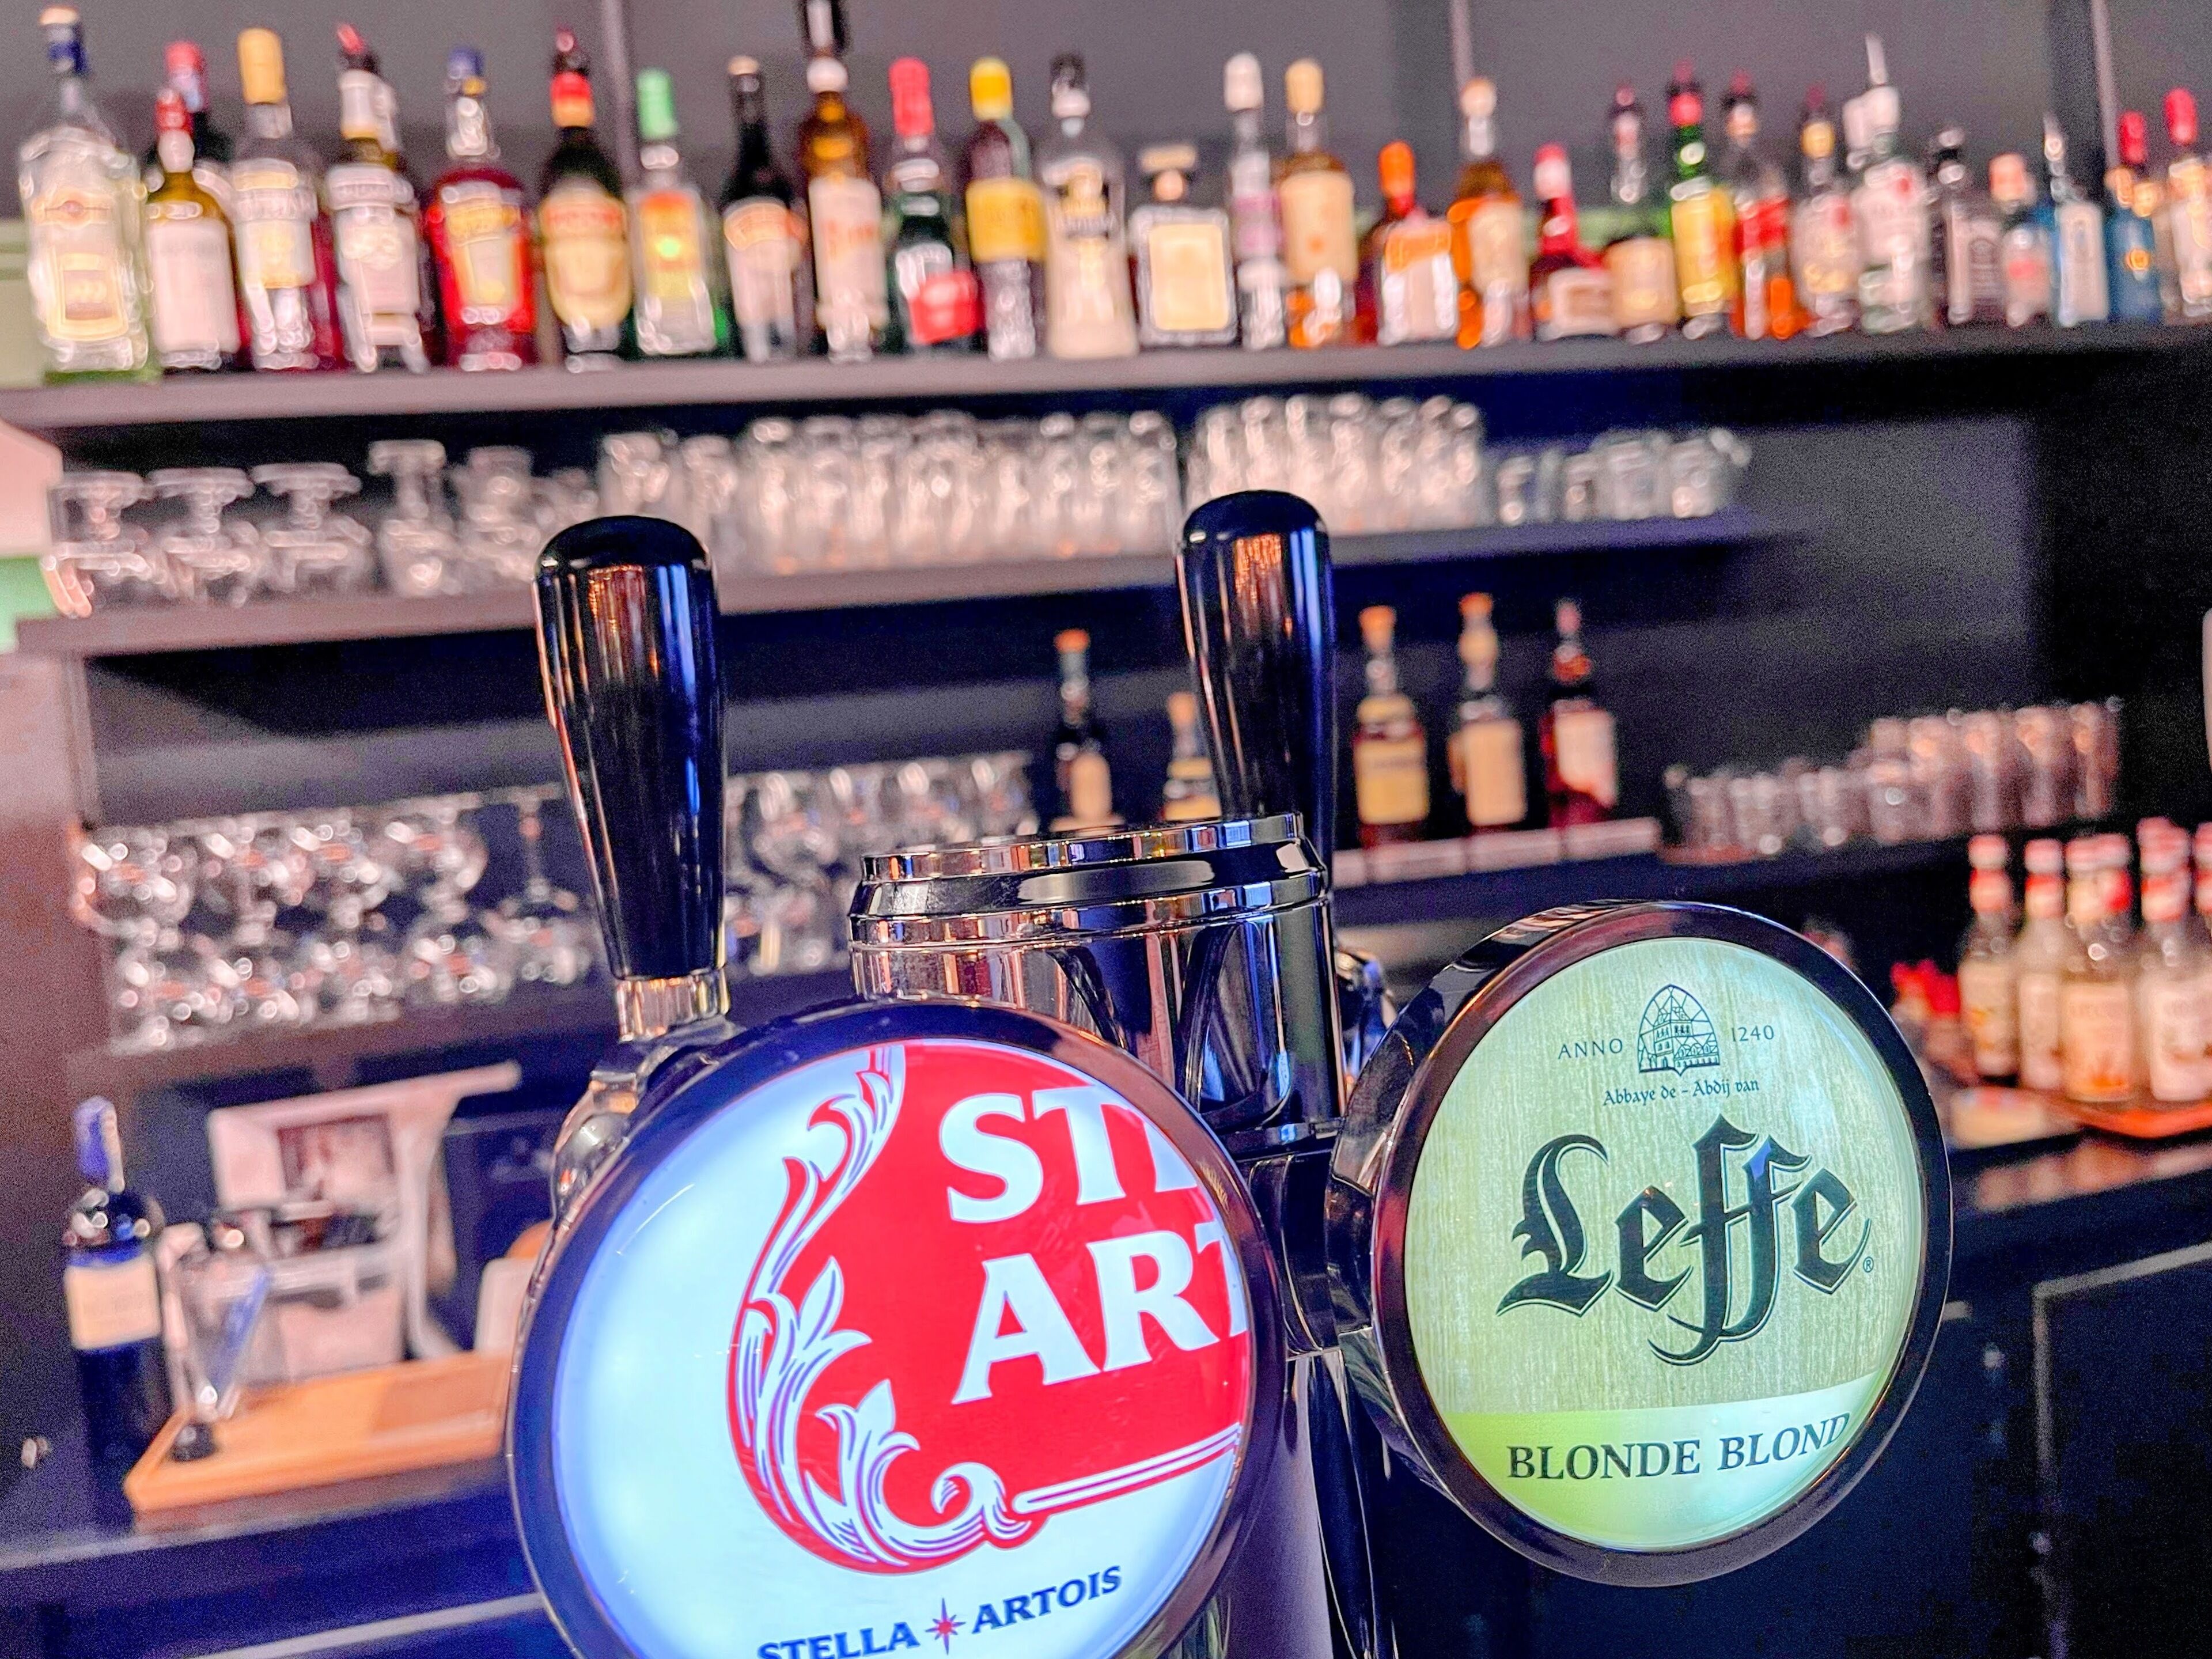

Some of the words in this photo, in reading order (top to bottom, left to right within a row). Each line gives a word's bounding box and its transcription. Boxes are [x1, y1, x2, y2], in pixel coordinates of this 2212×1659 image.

[1558, 1038, 1623, 1060] ANNO
[1731, 1025, 1775, 1042] 1240
[1603, 1089, 1656, 1106] Abbaye
[1661, 1086, 1676, 1099] de
[1692, 1079, 1731, 1098] Abdij
[1736, 1078, 1760, 1093] van
[1495, 1113, 1872, 1366] Leffe
[1506, 1439, 1701, 1480] BLONDE
[1717, 1412, 1851, 1471] BLOND
[757, 1622, 921, 1659] STELLA
[971, 1565, 1123, 1635] ARTOIS
